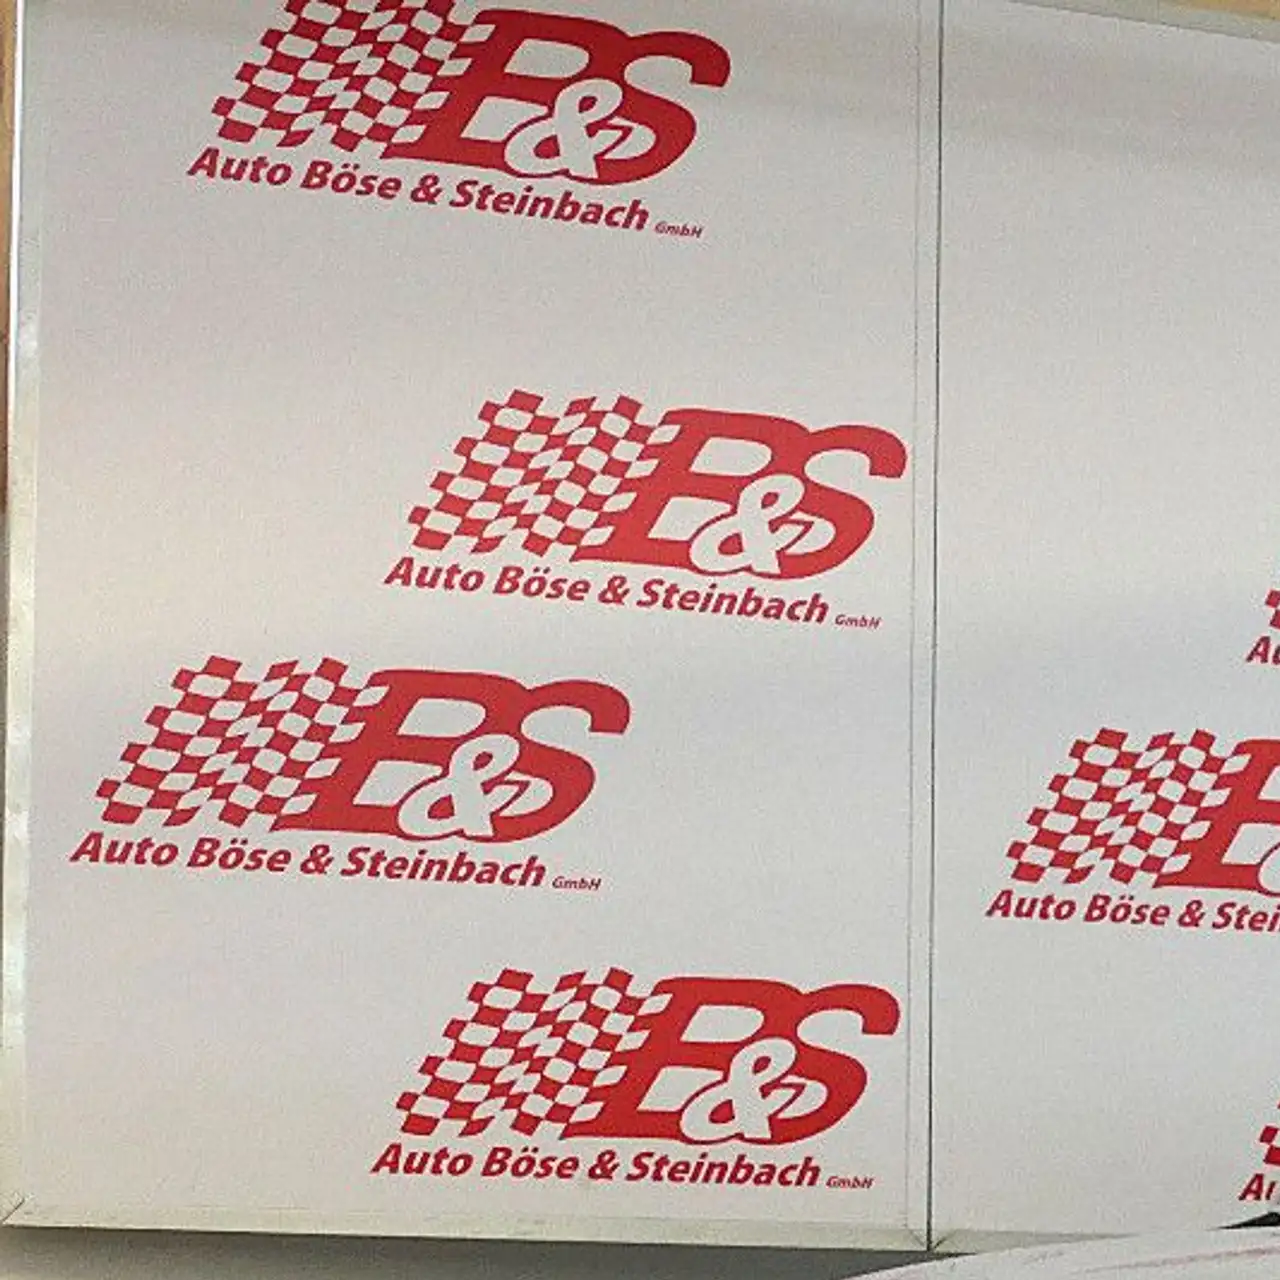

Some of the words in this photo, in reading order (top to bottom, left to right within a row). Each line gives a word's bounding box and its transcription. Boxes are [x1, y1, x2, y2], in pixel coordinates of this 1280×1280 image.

[386, 8, 731, 187] B&S
[188, 148, 292, 185] Auto
[301, 161, 401, 199] Böse
[411, 175, 442, 204] &
[449, 180, 648, 230] Steinbach
[654, 217, 704, 240] GmbH
[571, 407, 909, 582] B&S
[384, 557, 484, 591] Auto
[493, 566, 590, 600] Böse
[599, 576, 629, 605] &
[637, 579, 828, 623] Steinbach
[834, 613, 880, 630] GmbH
[270, 668, 632, 844] B&S
[70, 832, 178, 866] Auto
[187, 838, 291, 871] Böse
[300, 845, 333, 874] &
[340, 847, 545, 886] Steinbach
[552, 877, 602, 892] GmbH
[986, 890, 1076, 920] Auto
[1084, 894, 1170, 925] Böse
[1178, 900, 1205, 927] &
[561, 975, 902, 1148] B&S
[371, 1144, 473, 1176] Auto
[482, 1147, 579, 1178] Böse
[588, 1150, 619, 1180] &
[626, 1152, 820, 1186] Steinbach
[826, 1175, 874, 1190] GmbH
